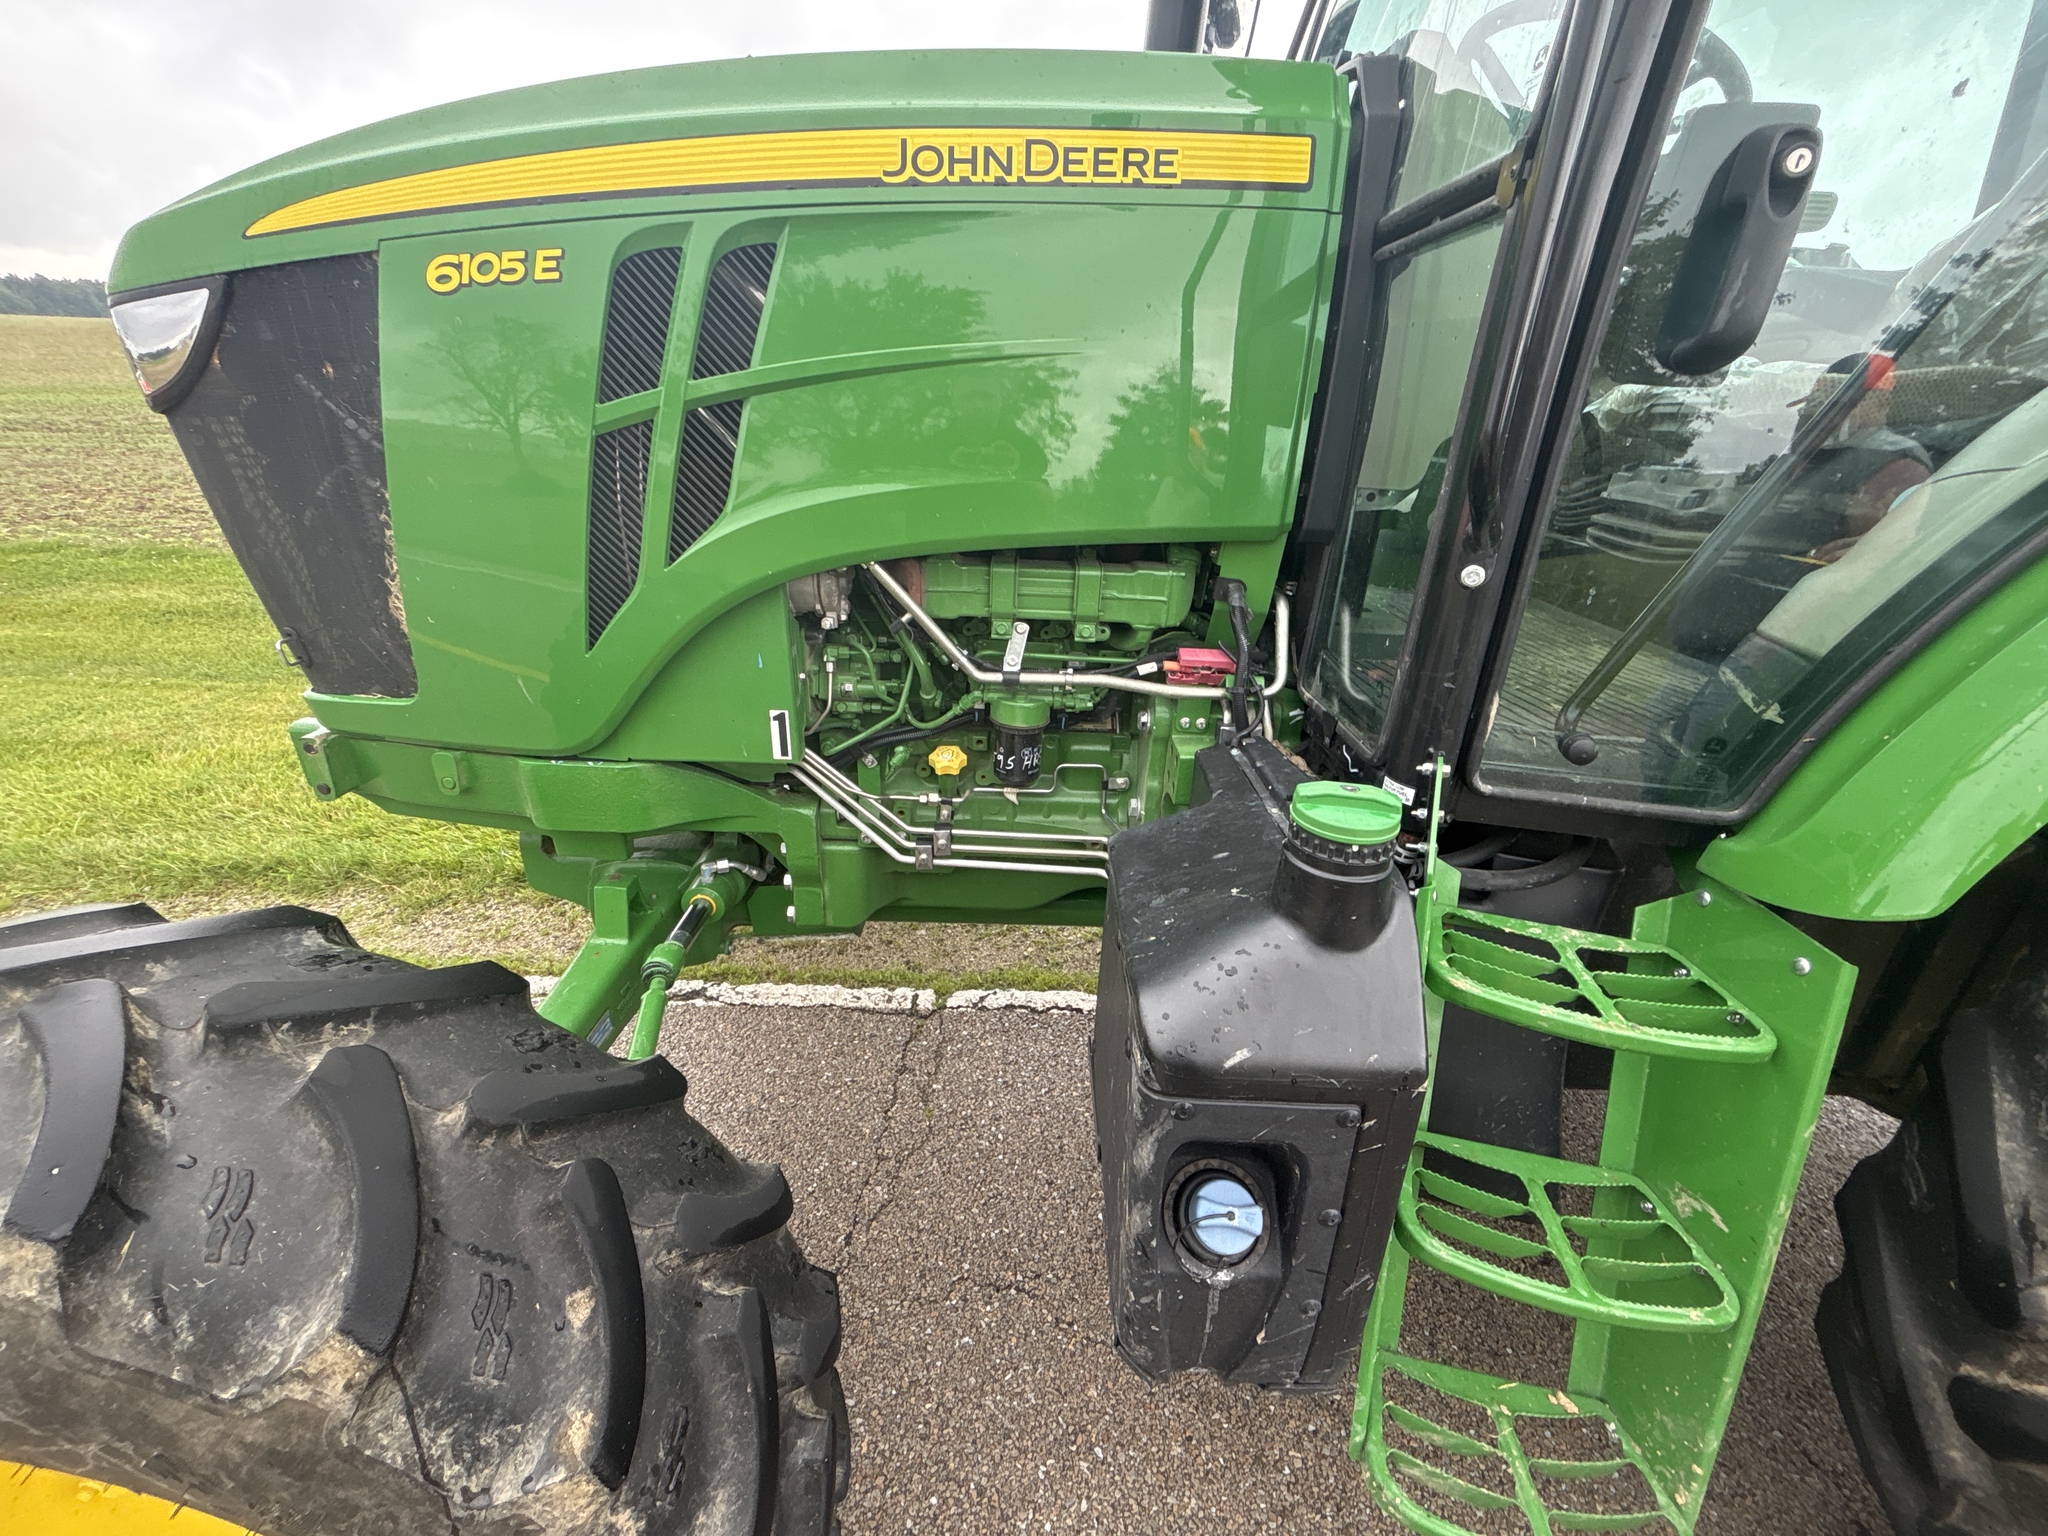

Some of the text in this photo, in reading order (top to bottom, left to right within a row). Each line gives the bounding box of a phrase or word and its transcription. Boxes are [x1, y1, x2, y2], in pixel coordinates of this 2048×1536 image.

[882, 137, 1180, 181] JOHN DEERE
[426, 248, 563, 294] 6105 E
[772, 711, 789, 757] 1
